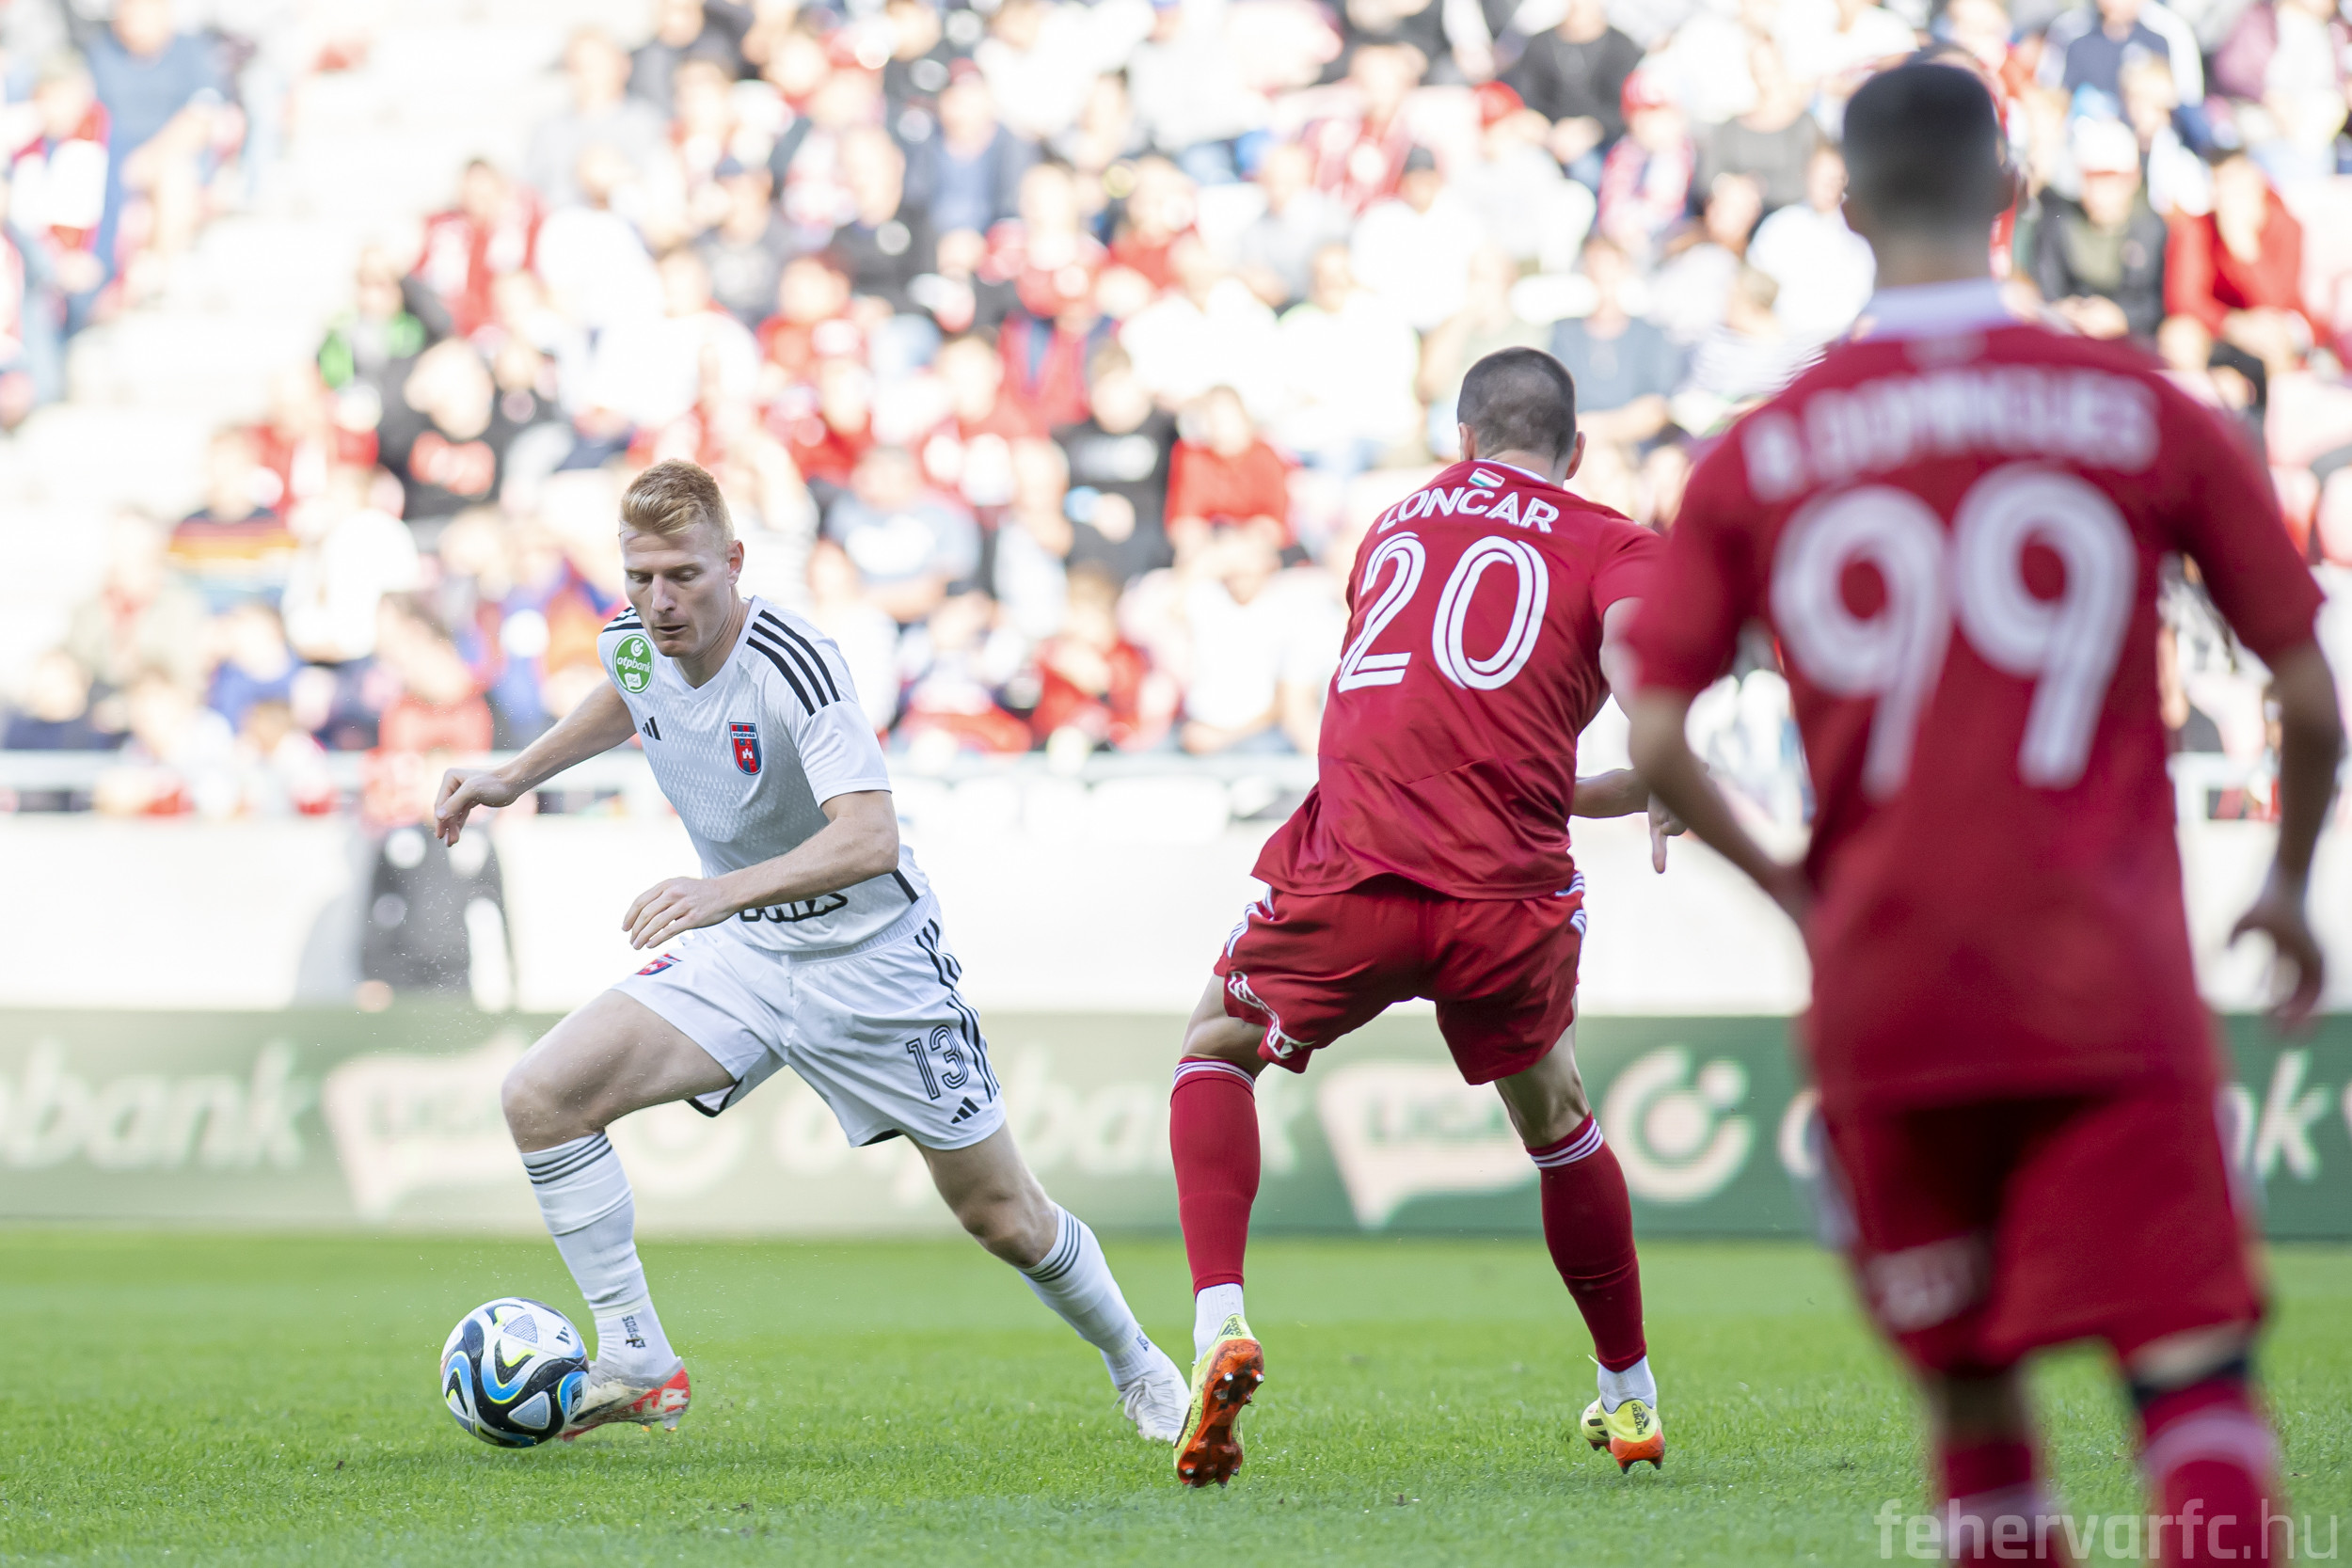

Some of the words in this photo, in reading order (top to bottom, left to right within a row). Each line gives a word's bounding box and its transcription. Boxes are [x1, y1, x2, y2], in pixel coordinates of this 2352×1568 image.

[616, 657, 652, 673] otpbank
[1337, 531, 1549, 693] 20
[1771, 458, 2137, 801] 99
[0, 1037, 315, 1174] bank
[905, 1024, 968, 1101] 13
